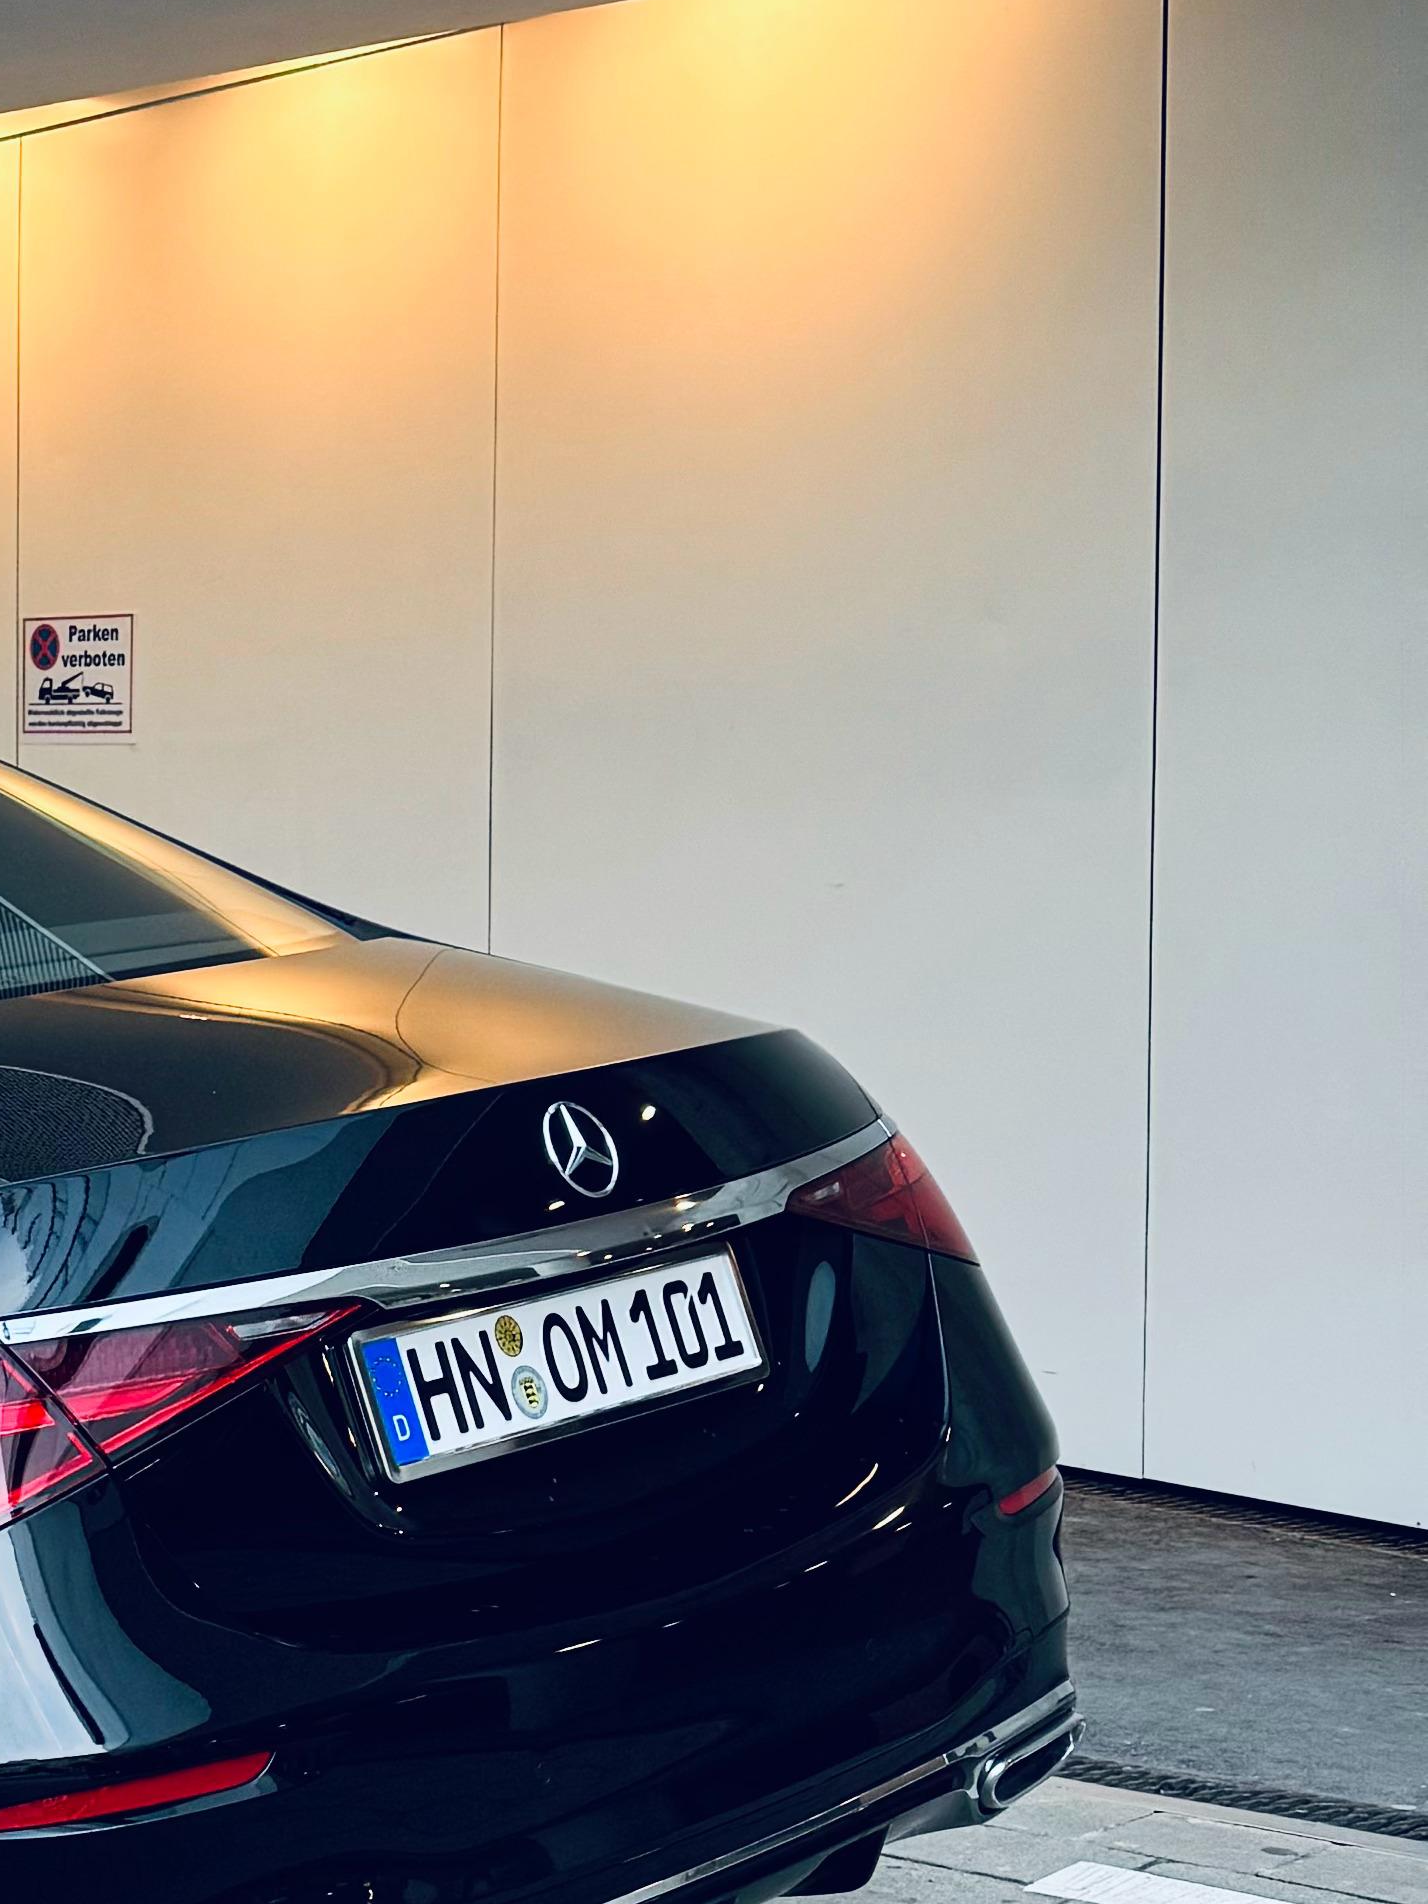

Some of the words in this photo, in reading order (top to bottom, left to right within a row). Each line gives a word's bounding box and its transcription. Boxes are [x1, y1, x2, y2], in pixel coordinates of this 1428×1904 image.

[68, 624, 119, 642] Parken
[61, 650, 126, 667] verboten
[406, 1329, 512, 1441] HN
[543, 1298, 633, 1402] OM
[629, 1271, 744, 1380] 101
[392, 1414, 411, 1441] D
